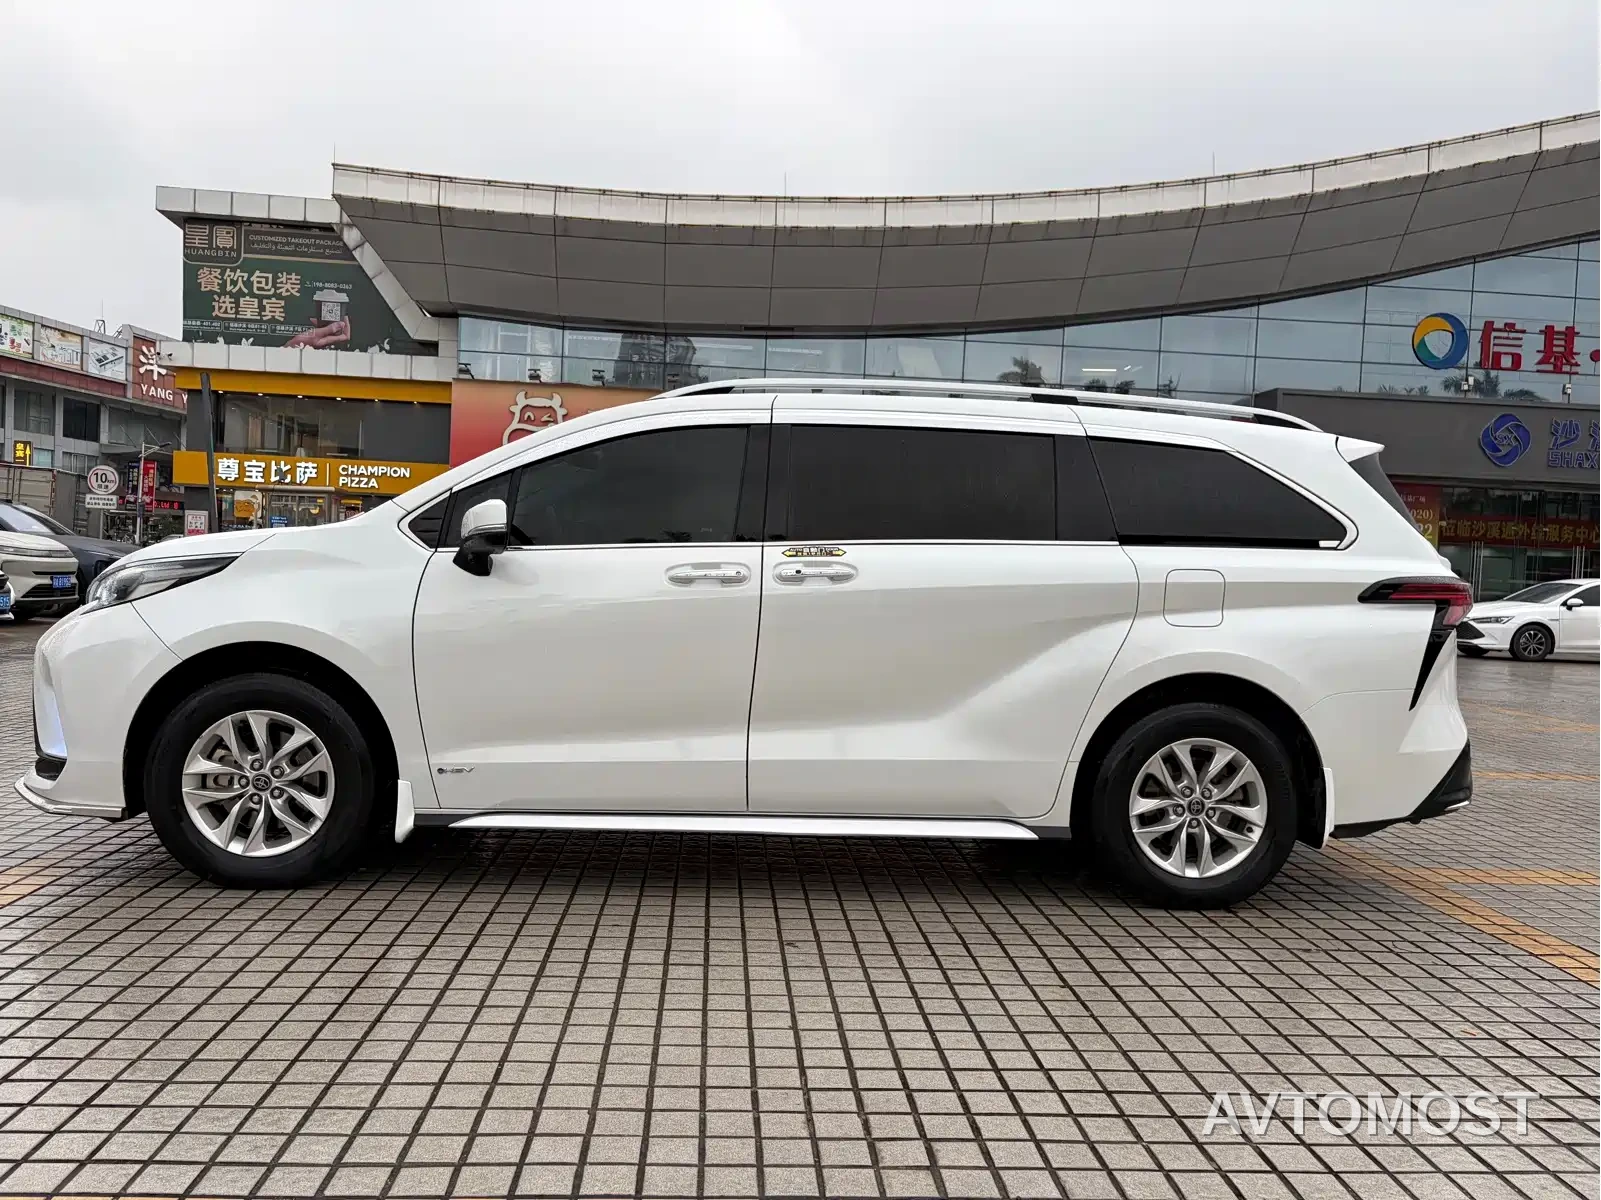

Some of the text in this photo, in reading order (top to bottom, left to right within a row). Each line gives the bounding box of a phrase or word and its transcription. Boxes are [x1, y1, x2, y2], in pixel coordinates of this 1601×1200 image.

[248, 234, 287, 242] CUSTOMIZED
[184, 247, 237, 258] HUANGBIN
[197, 266, 301, 297] 餐饮包装
[212, 294, 286, 321] 选皇宾
[140, 383, 173, 401] YANG
[217, 458, 318, 485] 尊宝比萨
[338, 464, 411, 478] CHAMPION
[339, 476, 379, 489] PIZZA
[1410, 508, 1433, 521] 020)
